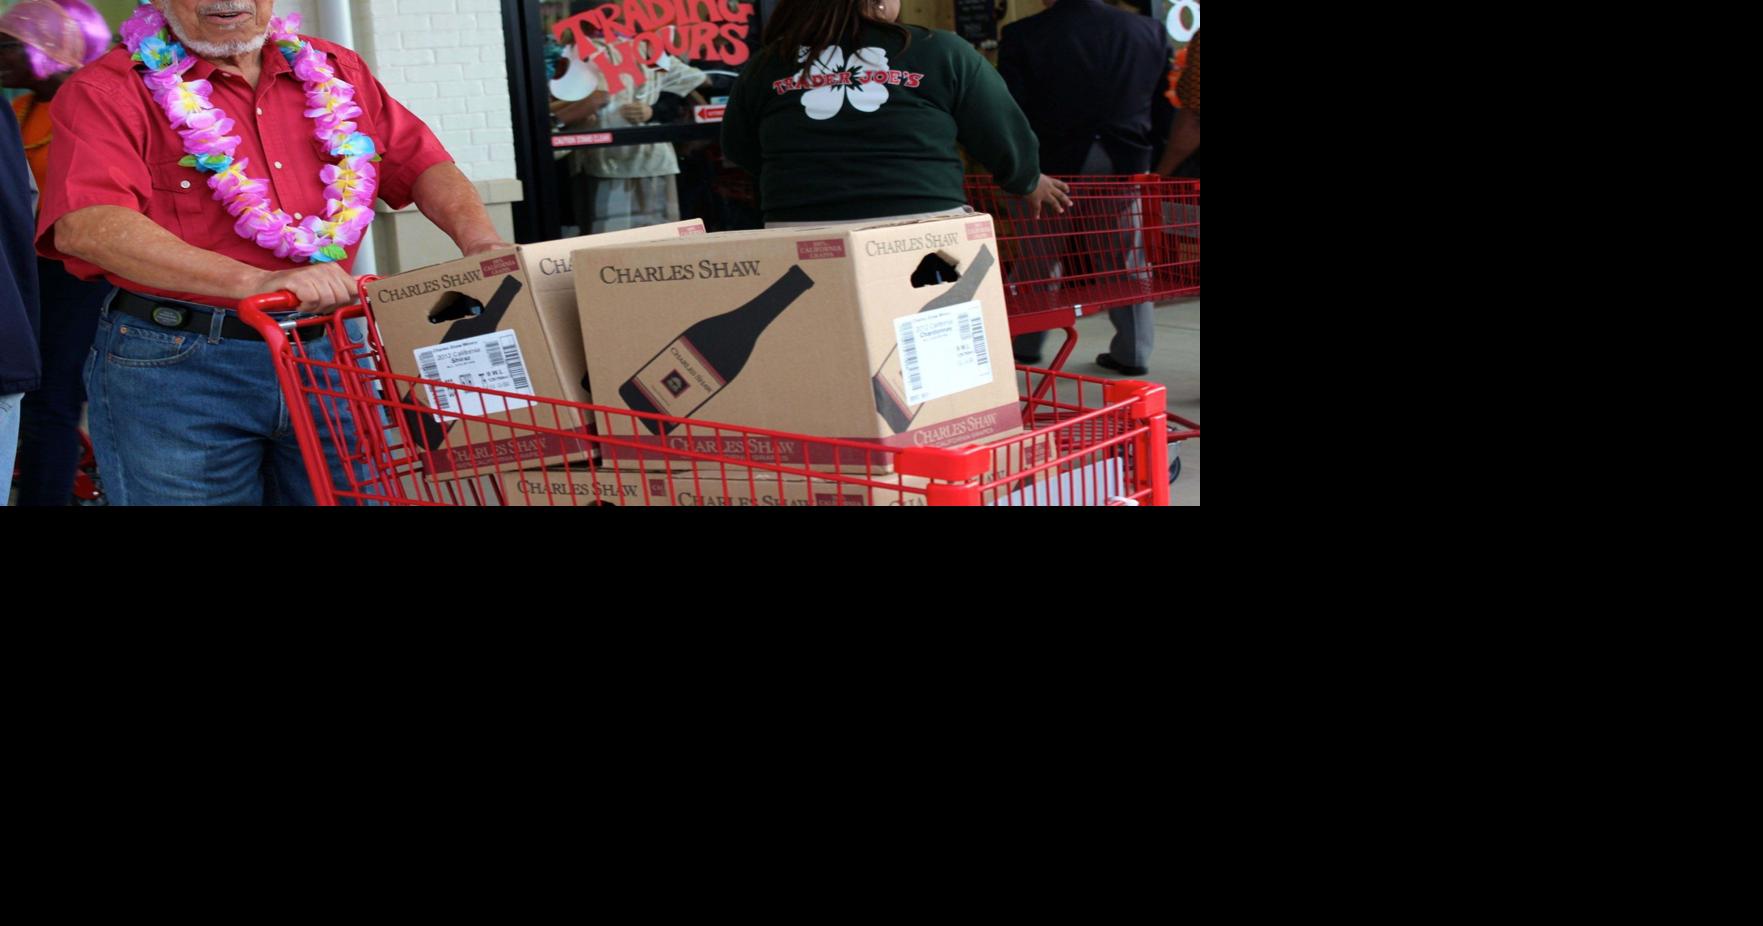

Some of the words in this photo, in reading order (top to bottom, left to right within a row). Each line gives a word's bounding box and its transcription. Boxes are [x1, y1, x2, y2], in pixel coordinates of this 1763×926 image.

[552, 0, 755, 60] TRADING
[592, 22, 750, 96] HOURS
[772, 71, 852, 95] TRADER
[857, 70, 925, 88] JOE'S
[865, 239, 924, 257] CHARLES
[924, 232, 959, 249] SHAW
[377, 279, 442, 304] CHARLES
[440, 269, 482, 290] SHAW
[599, 264, 695, 285] CHARLES
[912, 419, 967, 447] CHARLES
[967, 412, 998, 432] SHAW
